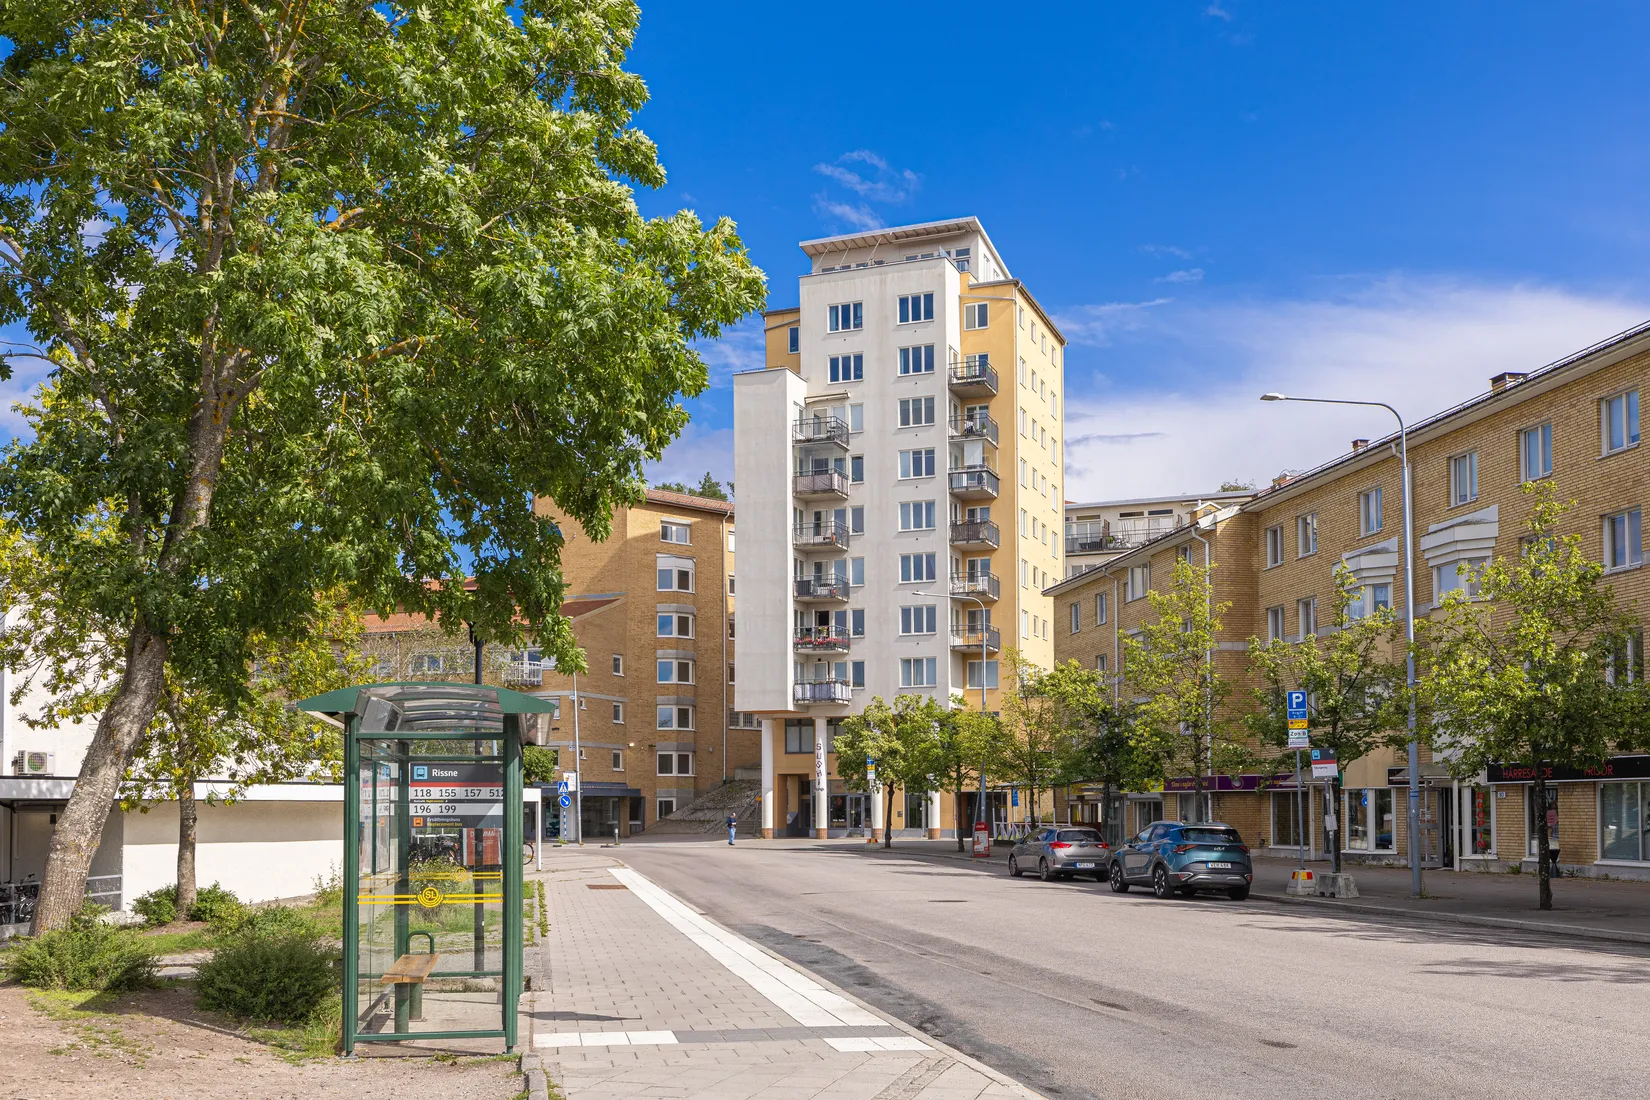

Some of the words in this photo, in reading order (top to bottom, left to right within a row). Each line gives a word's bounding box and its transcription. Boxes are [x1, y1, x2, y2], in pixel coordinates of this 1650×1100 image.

[1292, 693, 1303, 708] P
[432, 768, 458, 777] Rissne
[1502, 767, 1552, 778] HÅRRESADE
[414, 789, 432, 797] 118
[439, 789, 457, 797] 155
[464, 789, 482, 797] 157
[414, 805, 432, 813] 196
[439, 805, 457, 813] 199
[1477, 791, 1485, 827] DROP
[1477, 832, 1486, 848] IN
[425, 890, 436, 899] SL
